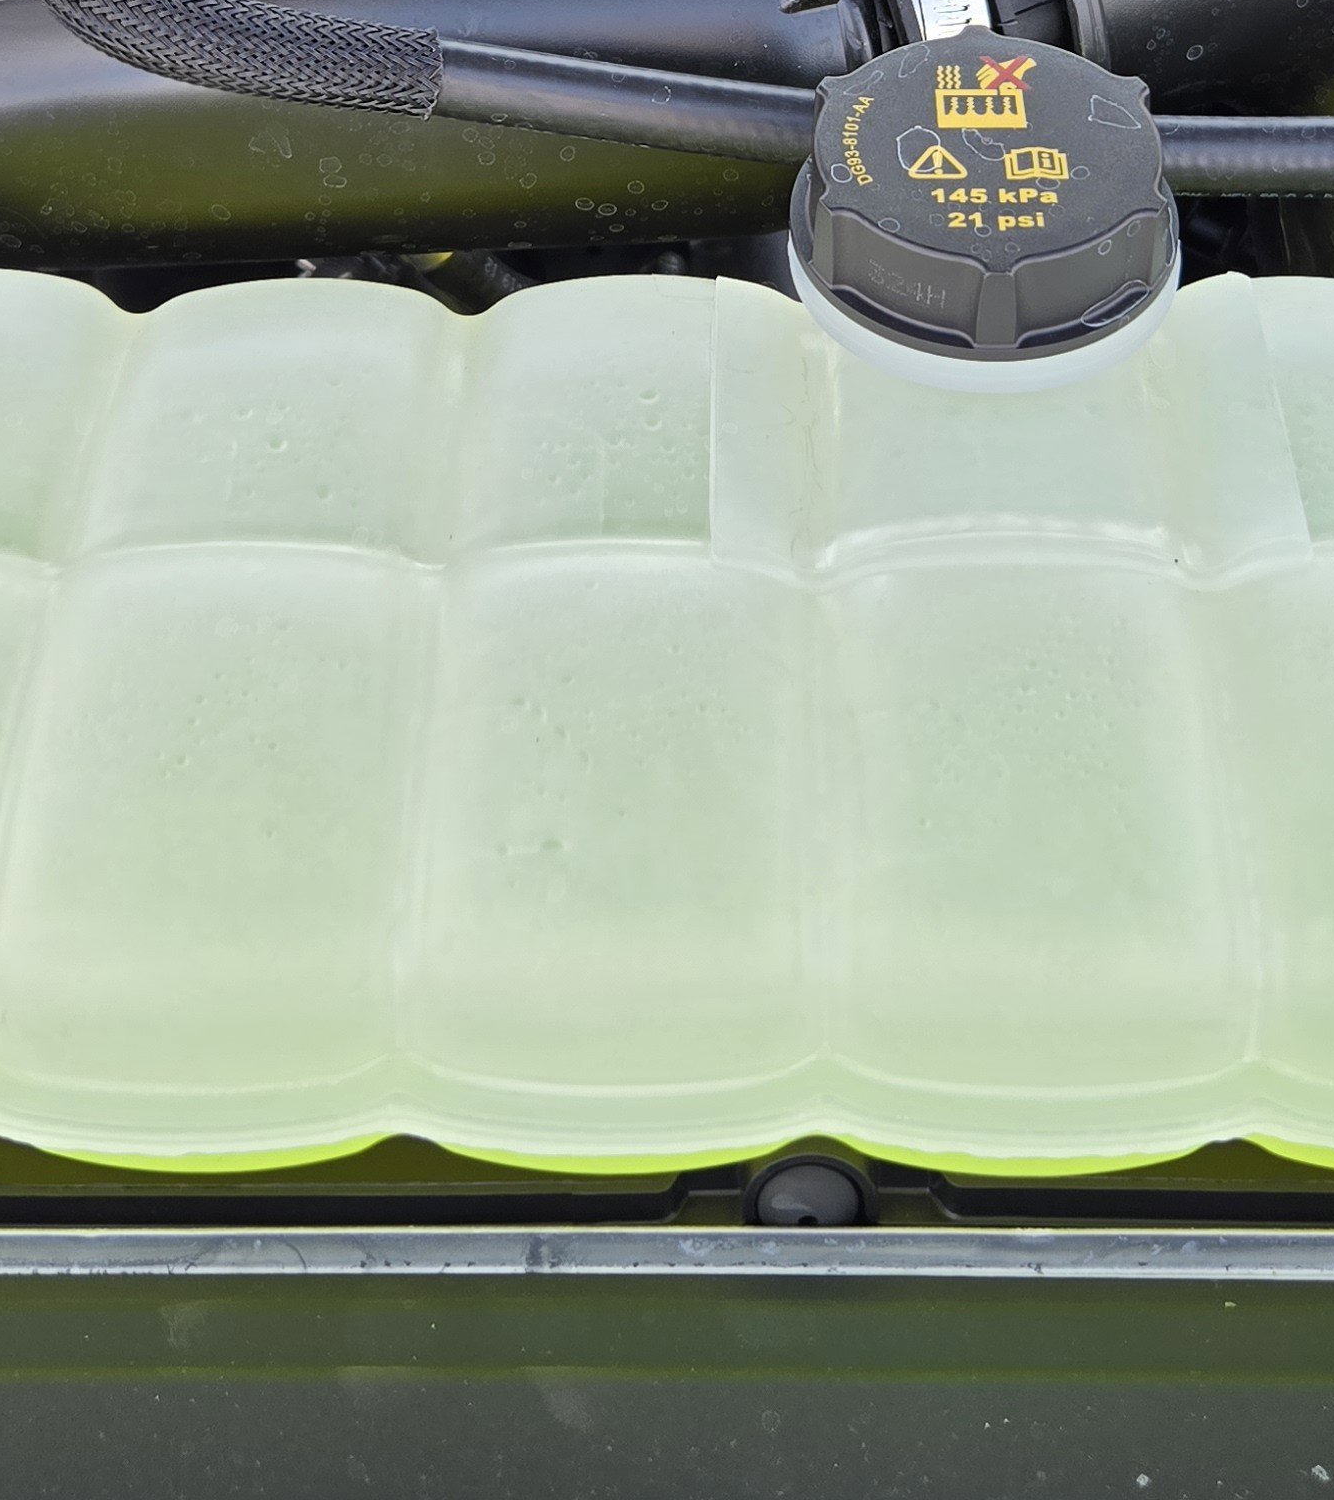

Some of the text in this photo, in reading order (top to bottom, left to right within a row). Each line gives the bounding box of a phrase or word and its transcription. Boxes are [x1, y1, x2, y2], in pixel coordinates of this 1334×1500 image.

[842, 96, 875, 186] DG93-8101-AA
[931, 188, 1058, 204] 145 kPa
[948, 212, 1045, 231] 21 psi
